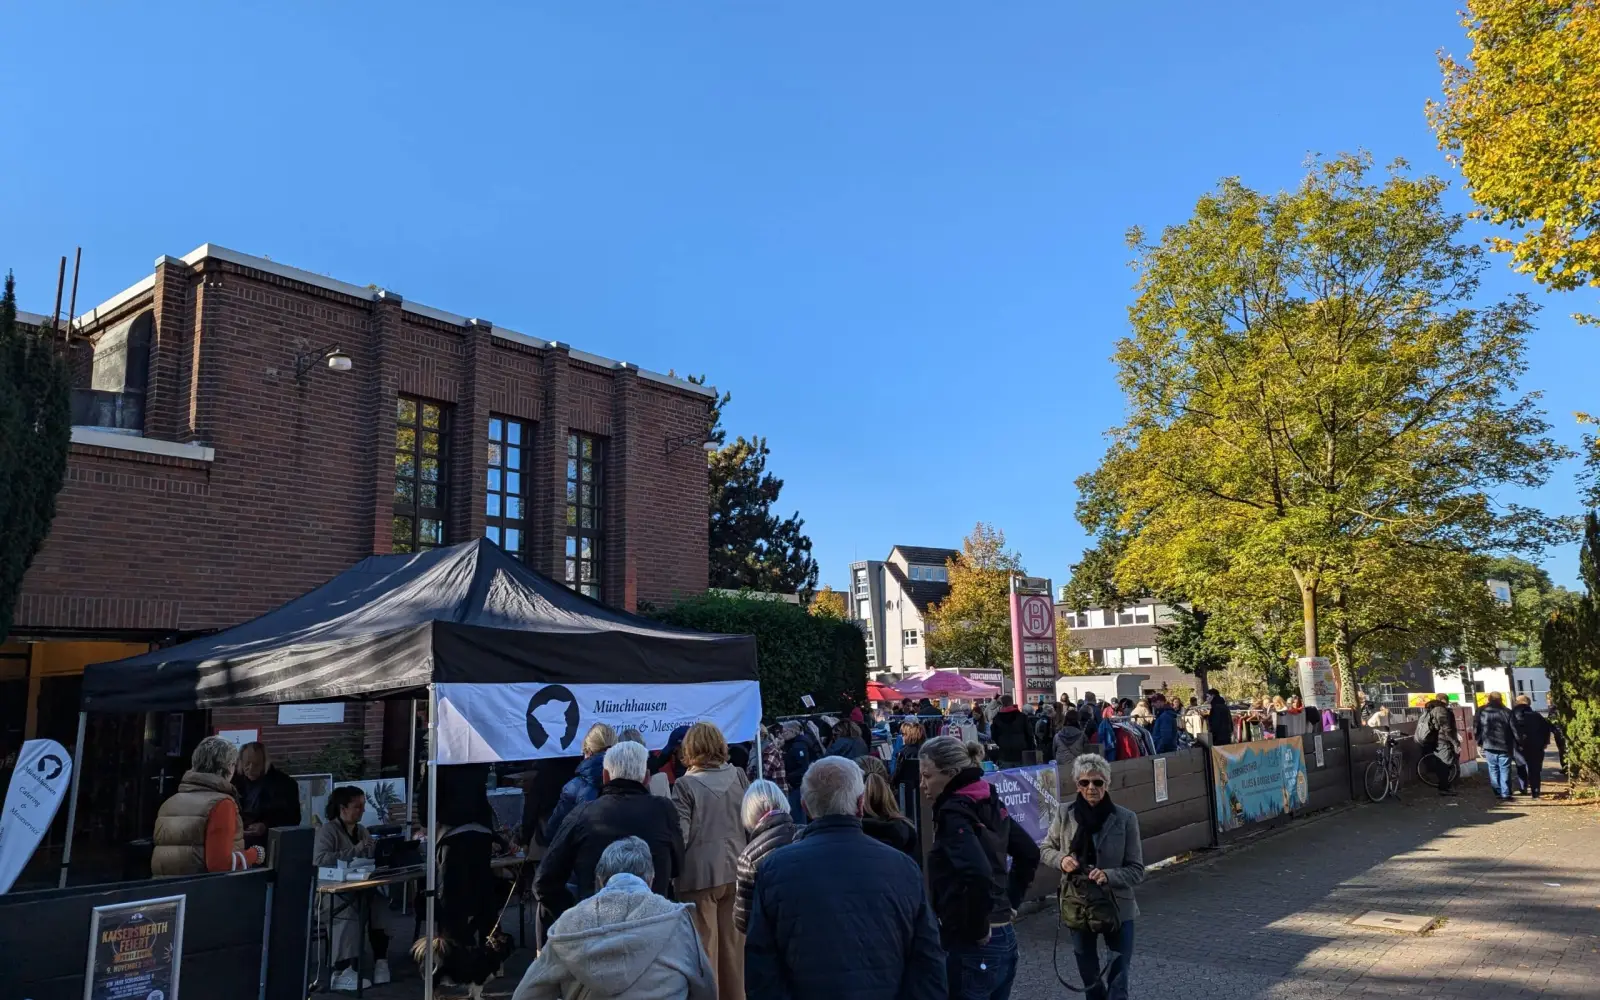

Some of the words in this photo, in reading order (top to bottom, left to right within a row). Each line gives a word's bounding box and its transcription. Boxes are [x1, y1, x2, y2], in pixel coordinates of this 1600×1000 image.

[1027, 678, 1054, 689] Service
[593, 698, 667, 714] Münchhausen
[638, 720, 649, 733] &
[25, 765, 57, 796] Münchhausen
[19, 786, 41, 808] Catering
[1004, 792, 1031, 806] OUTLET
[1033, 780, 1058, 807] KOLLEKTIO
[10, 807, 41, 836] Messeservice
[102, 921, 168, 943] KAISERSWERTH
[120, 936, 150, 952] FEIERT
[106, 966, 112, 974] 9.
[113, 962, 142, 972] NOVEMBER
